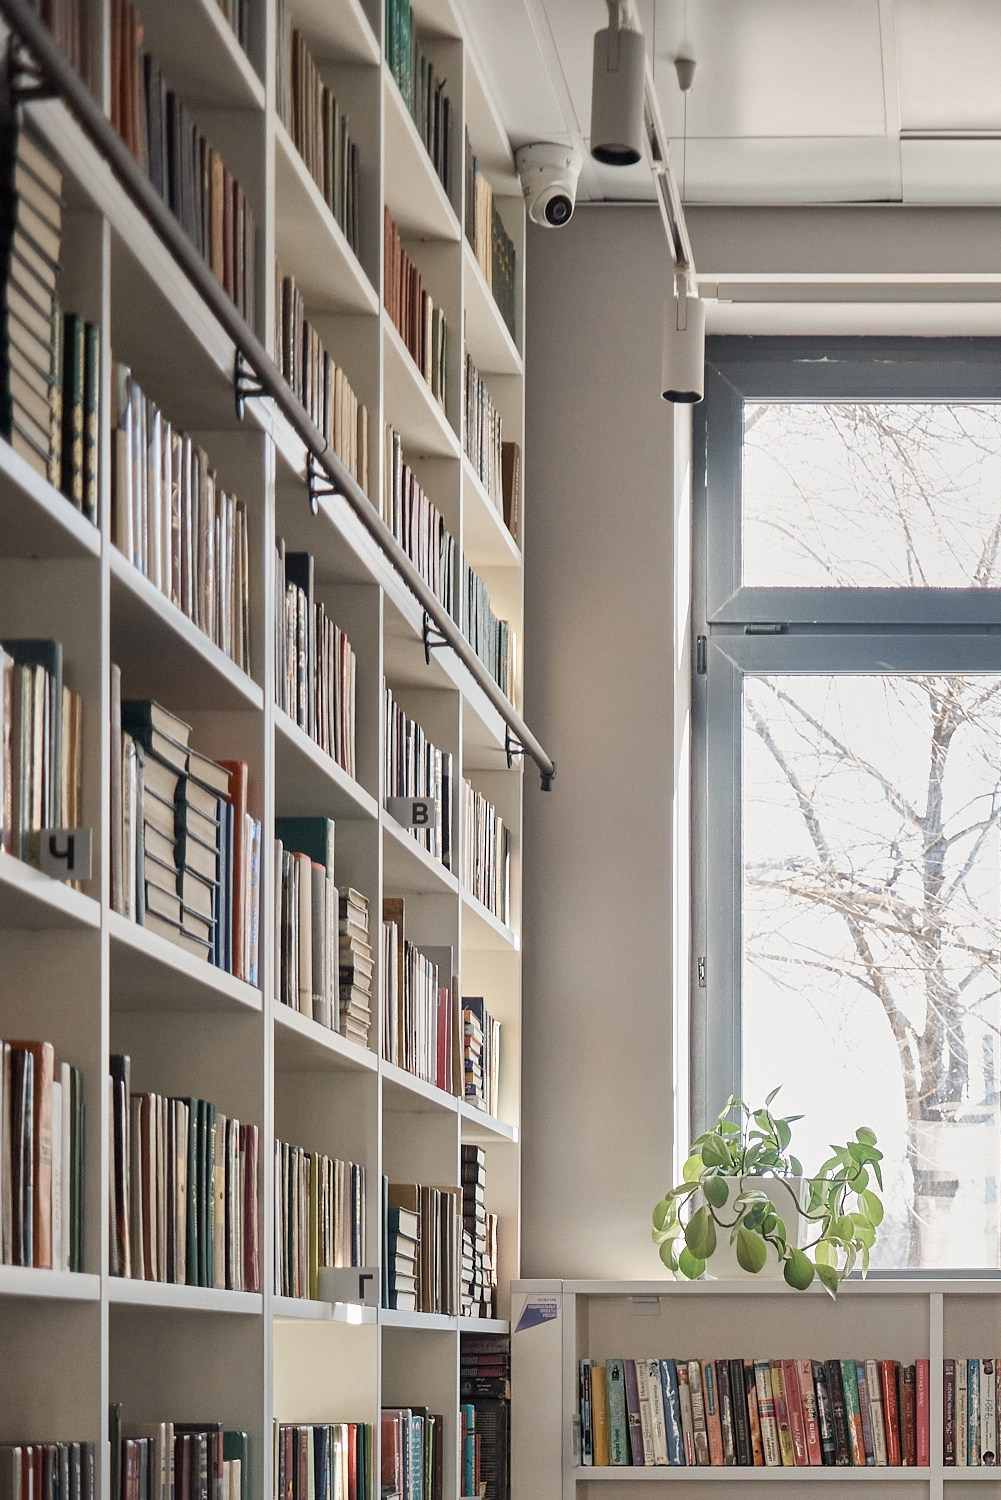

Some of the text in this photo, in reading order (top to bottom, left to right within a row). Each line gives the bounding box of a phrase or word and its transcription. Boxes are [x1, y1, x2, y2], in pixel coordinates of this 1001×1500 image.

[412, 803, 430, 825] В
[50, 834, 75, 870] Ч
[359, 1273, 374, 1299] Г
